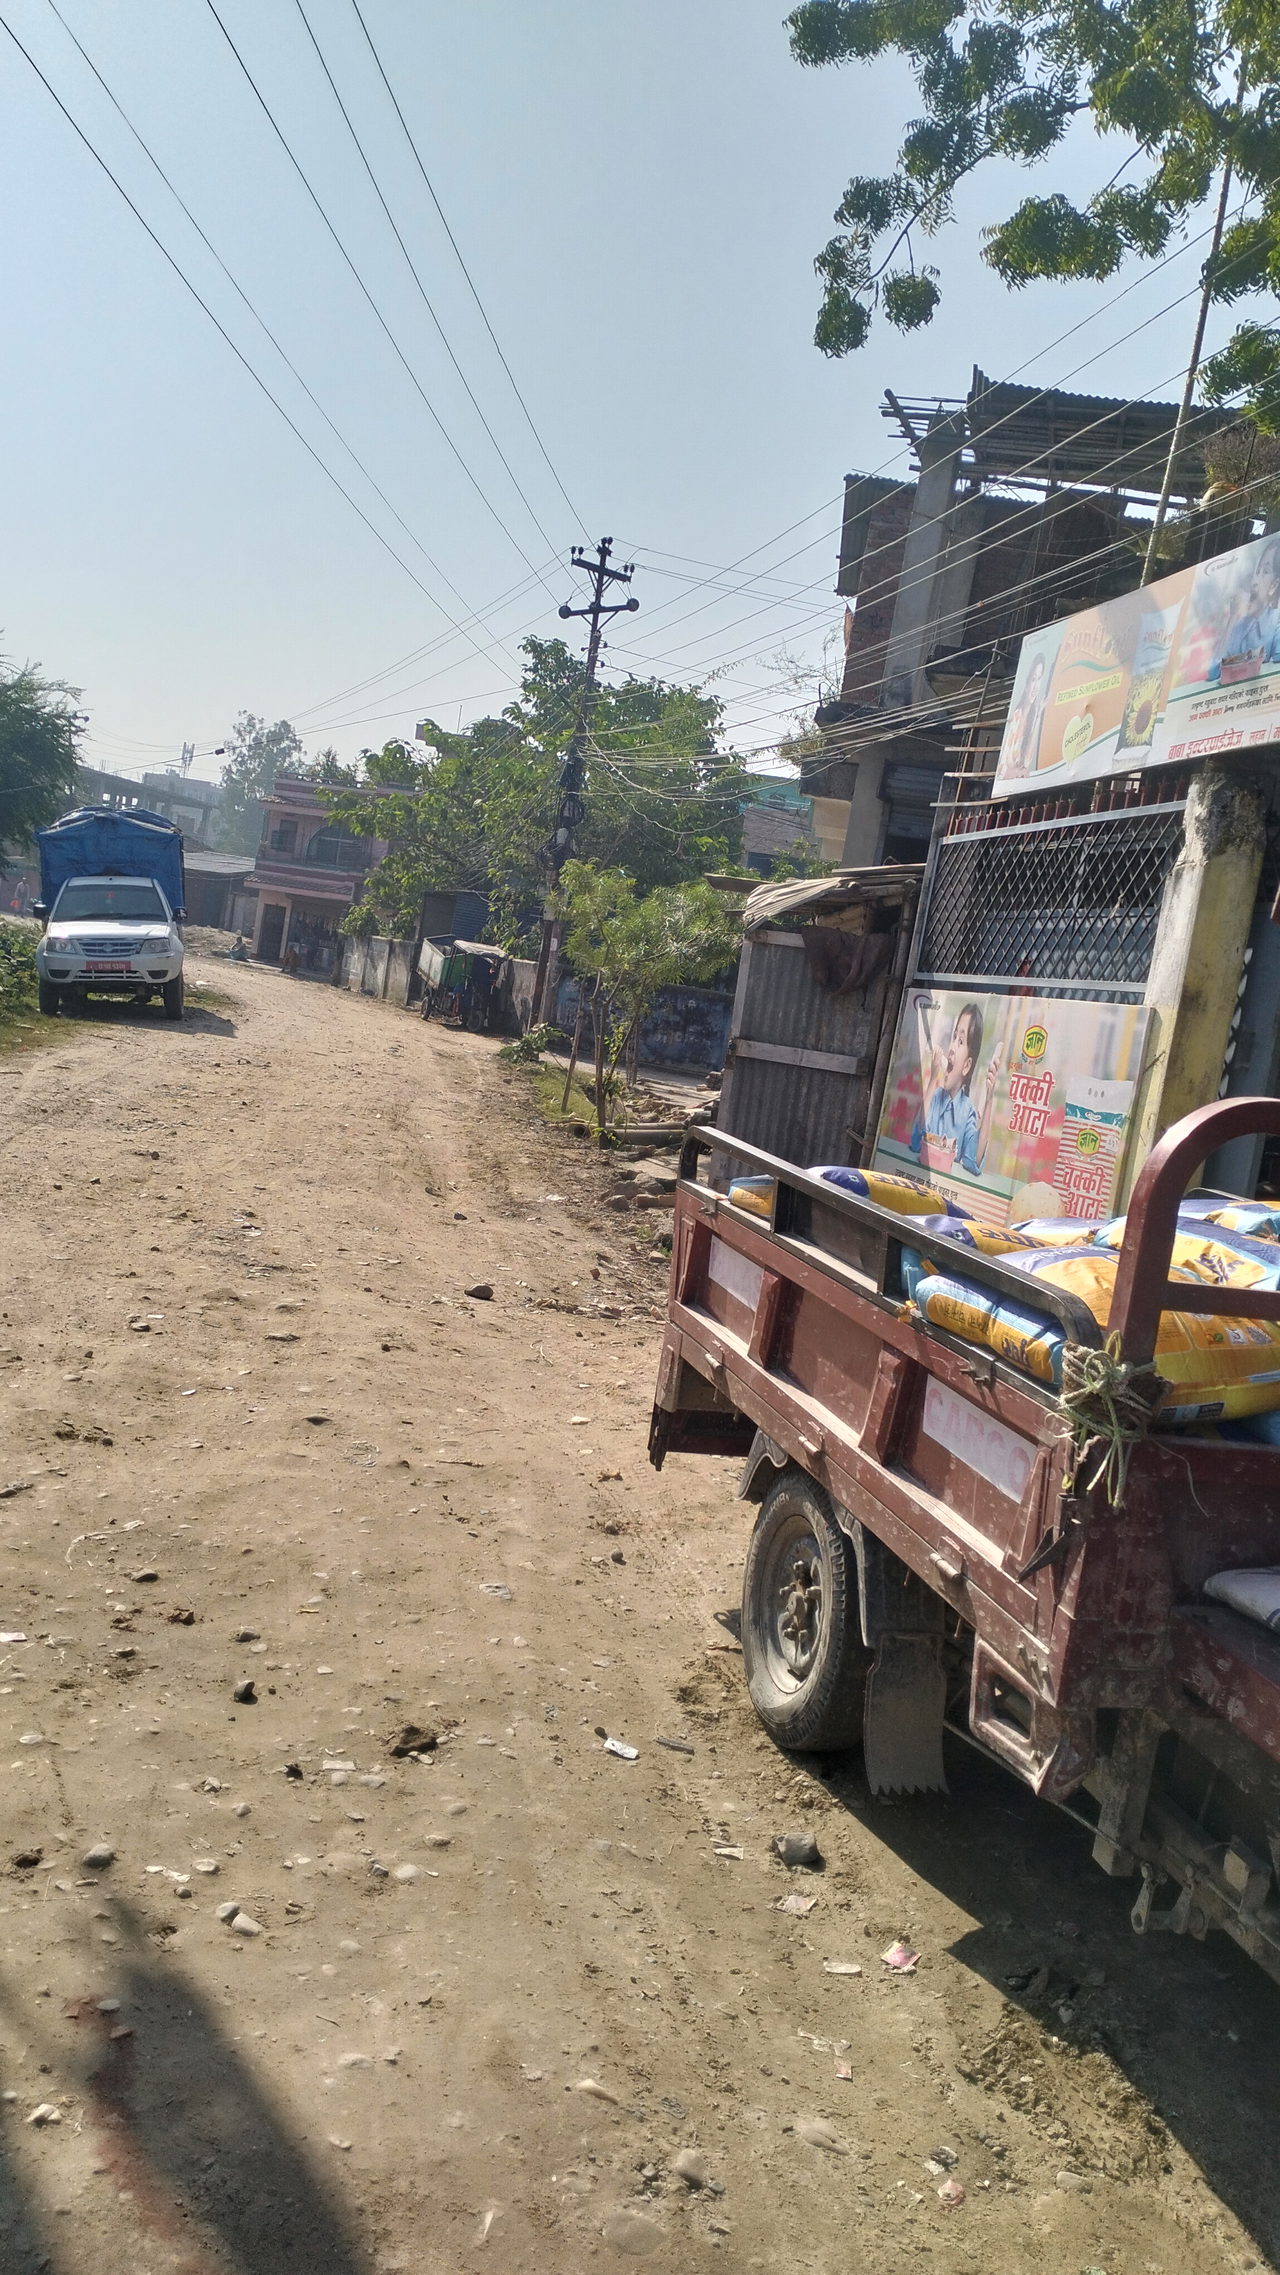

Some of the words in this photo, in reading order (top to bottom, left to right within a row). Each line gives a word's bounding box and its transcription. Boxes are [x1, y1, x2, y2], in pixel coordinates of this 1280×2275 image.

[1009, 1071, 1055, 1107] चक्की
[1009, 1103, 1051, 1137] आटा
[1063, 1166, 1105, 1196] चक्की
[1065, 1191, 1103, 1220] आटा
[925, 1387, 1030, 1496] CARGO
